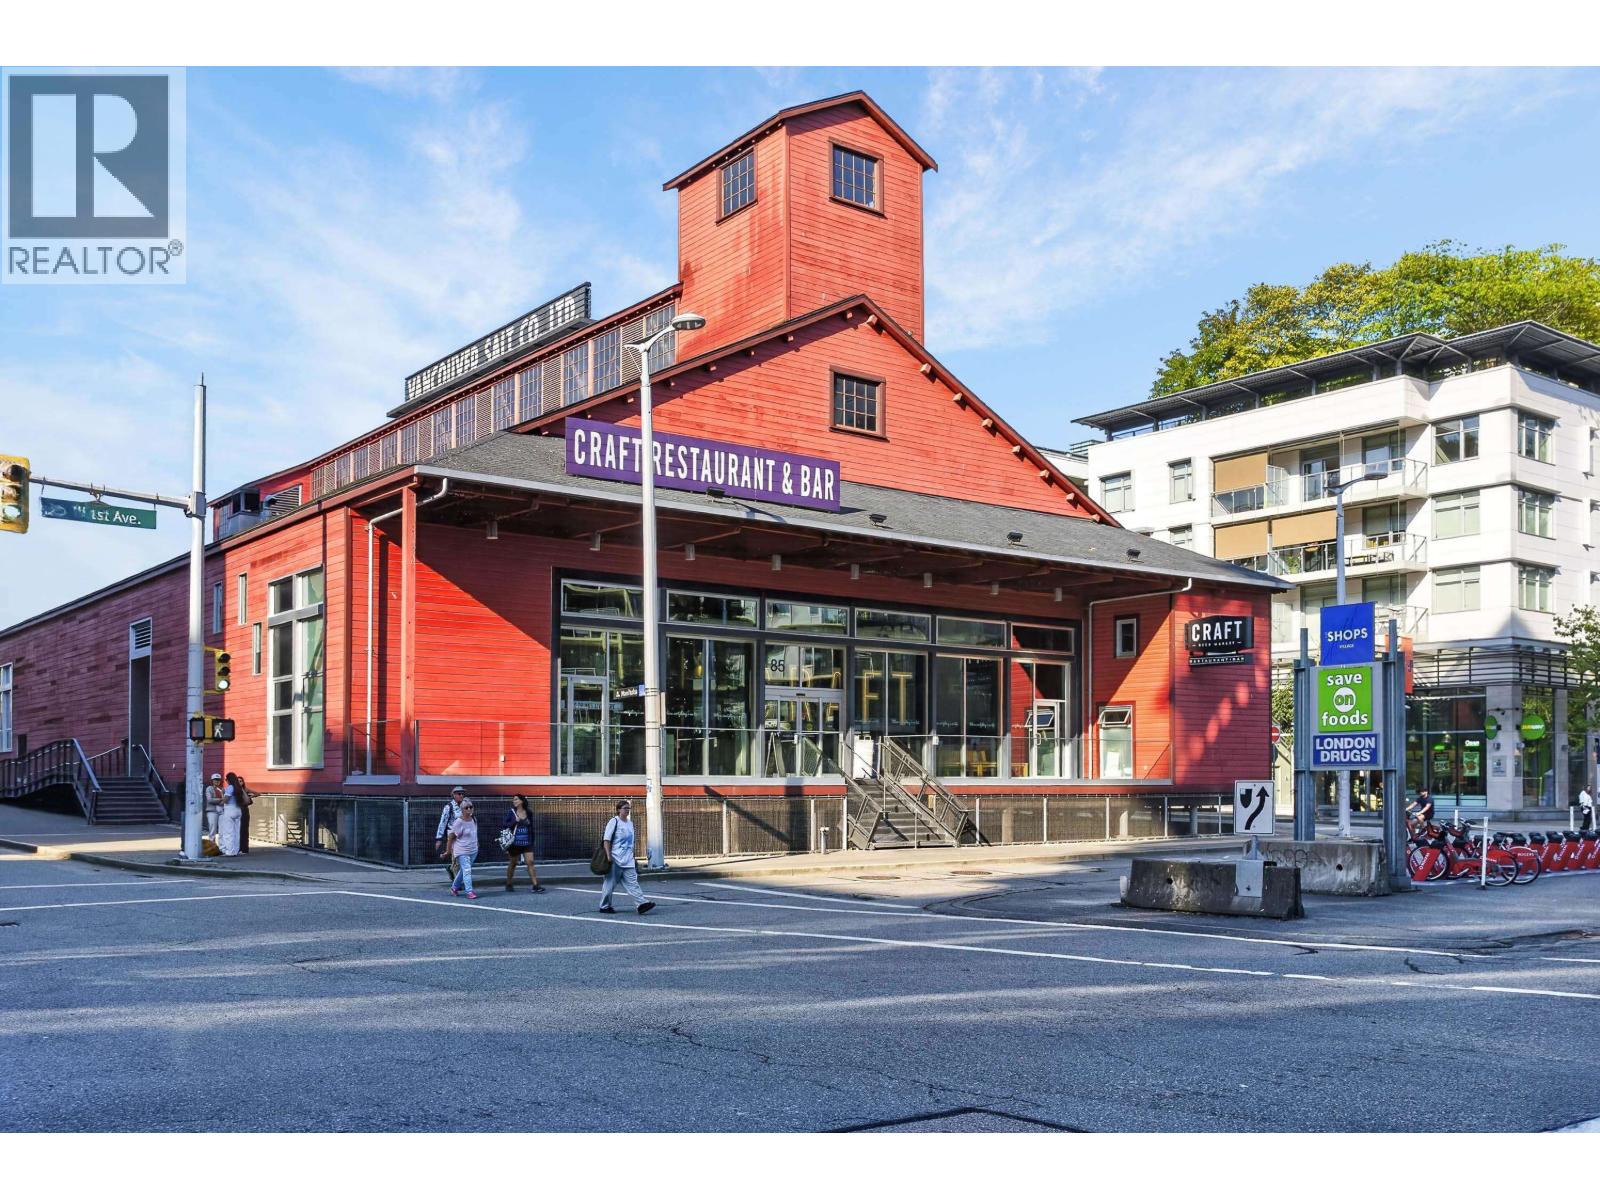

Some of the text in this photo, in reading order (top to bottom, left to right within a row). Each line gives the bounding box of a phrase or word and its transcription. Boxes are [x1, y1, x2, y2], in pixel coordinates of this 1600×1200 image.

[573, 428, 834, 501] CRAFT RESTAURANT & BAR
[90, 509, 110, 522] 1st
[113, 510, 142, 525] Ave.
[1191, 620, 1243, 642] CRAFT
[1327, 627, 1369, 642] SHOPS
[770, 658, 785, 673] 85
[1327, 673, 1363, 686] save
[1334, 694, 1354, 706] on
[1321, 709, 1369, 727] foods
[1315, 736, 1376, 751] LONDON
[1320, 749, 1372, 763] DRUGS
